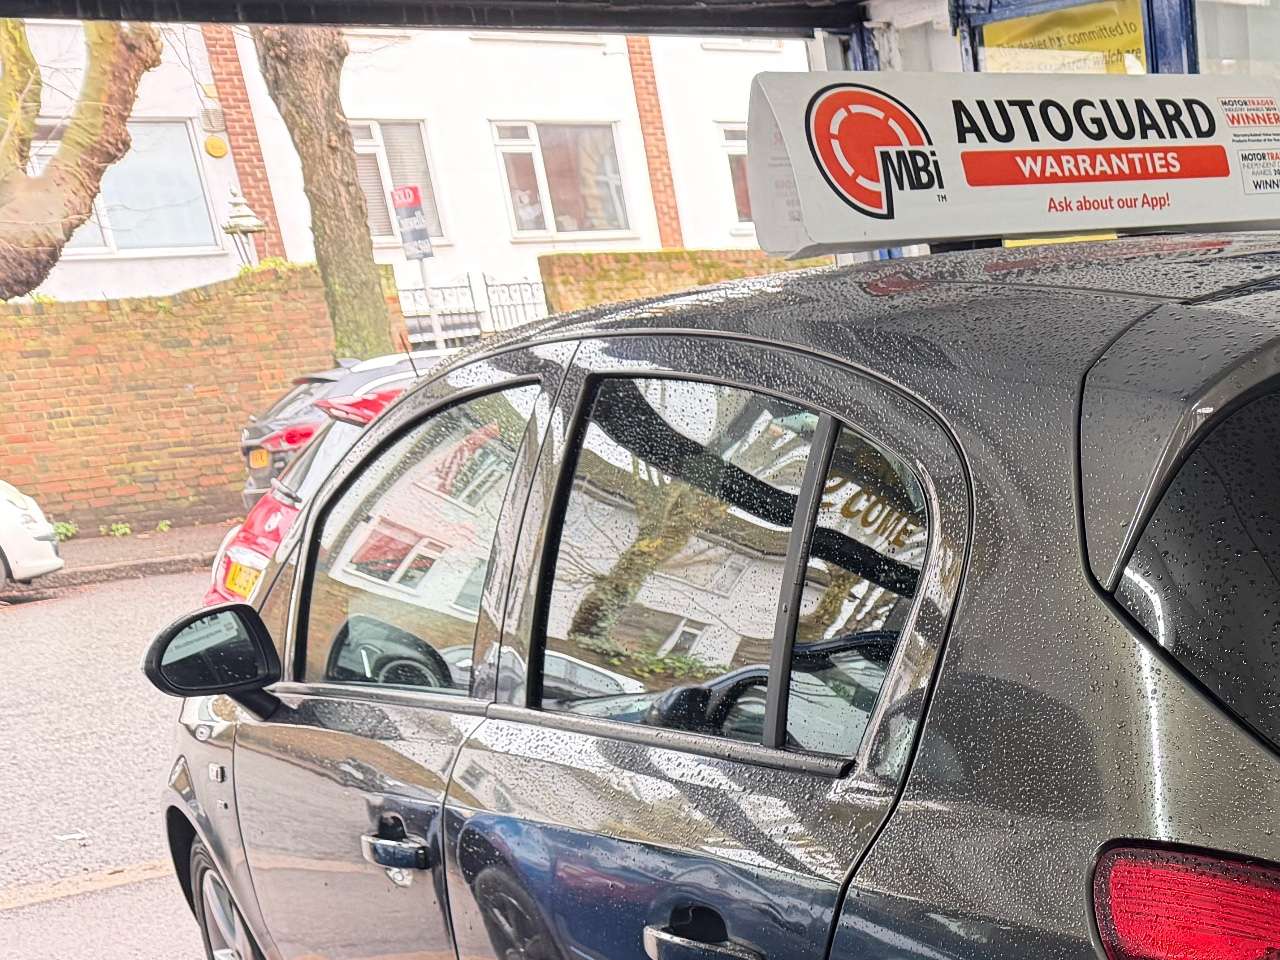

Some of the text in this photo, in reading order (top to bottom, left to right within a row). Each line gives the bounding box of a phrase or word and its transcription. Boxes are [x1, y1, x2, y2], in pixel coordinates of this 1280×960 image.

[1068, 24, 1124, 46] committed
[1125, 20, 1137, 34] to
[951, 98, 1217, 144] AUTOGUARD
[880, 149, 944, 192] MBi
[1014, 151, 1182, 180] WARRANTIES
[1047, 191, 1171, 212] Ask about our App!
